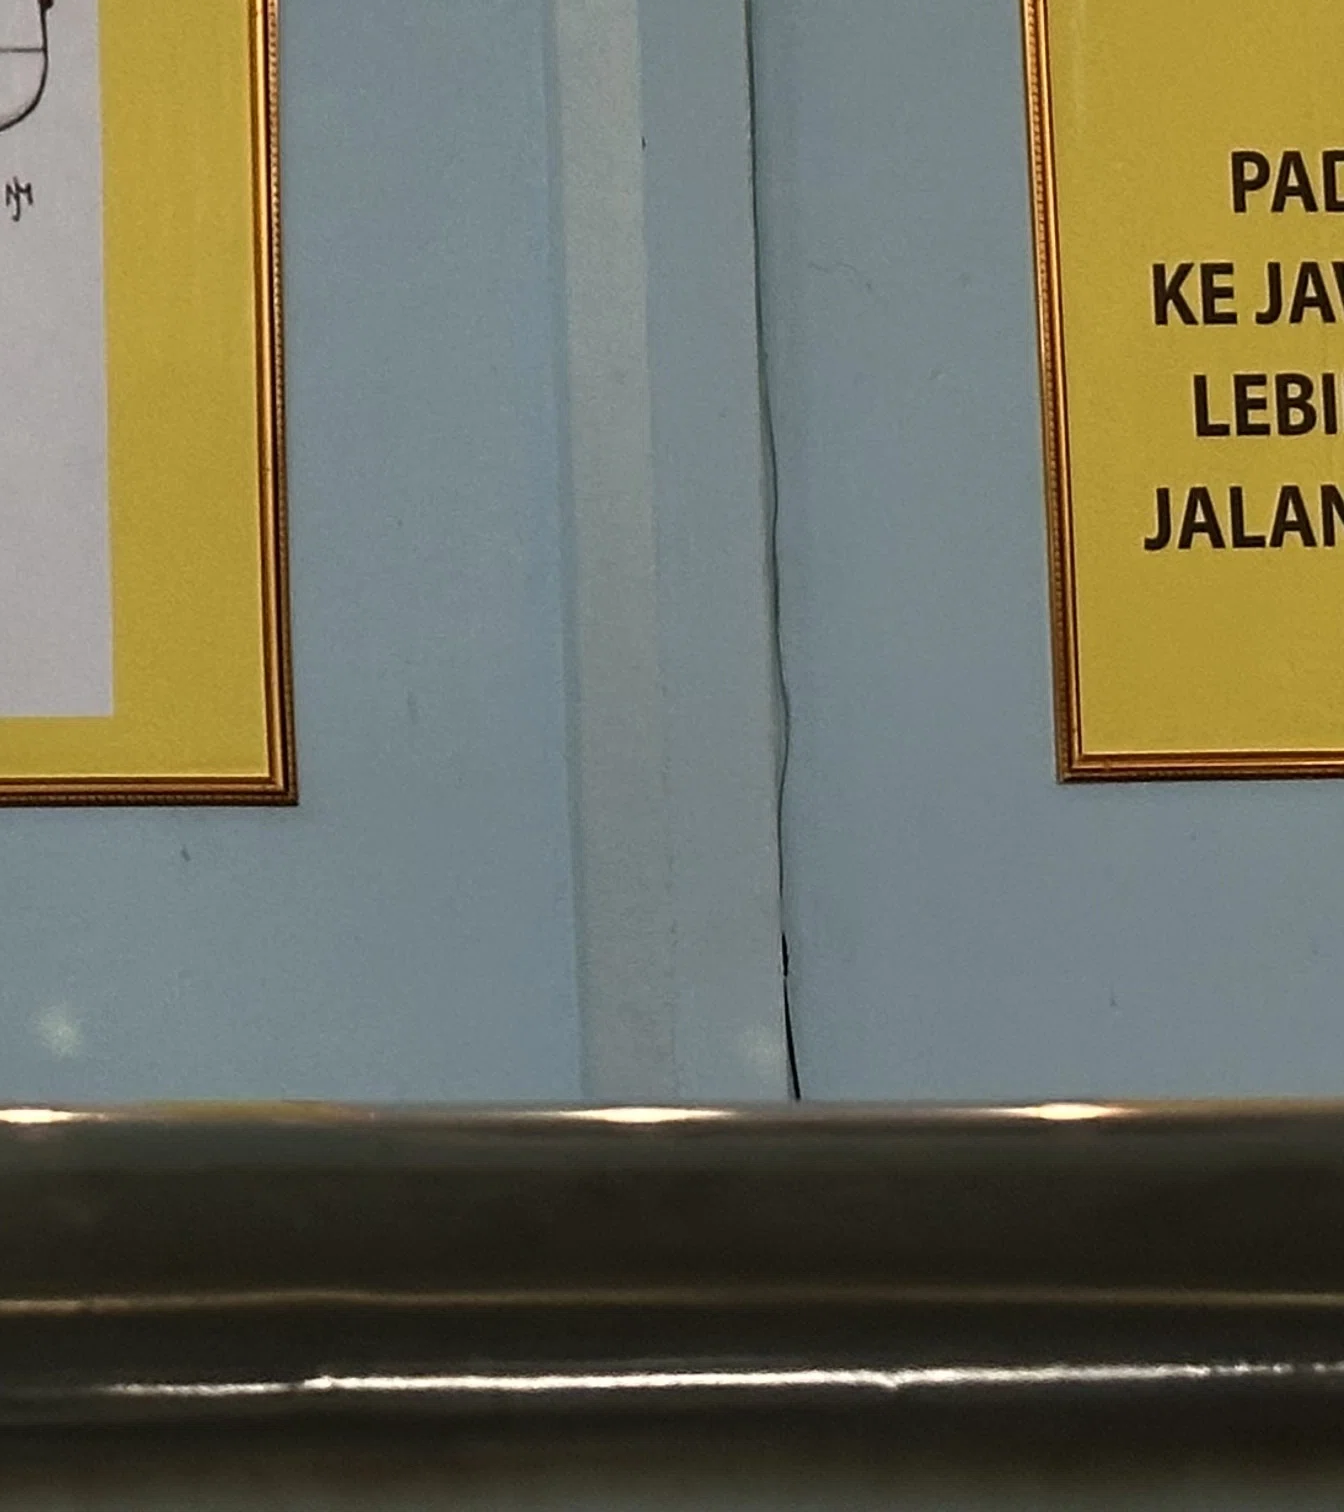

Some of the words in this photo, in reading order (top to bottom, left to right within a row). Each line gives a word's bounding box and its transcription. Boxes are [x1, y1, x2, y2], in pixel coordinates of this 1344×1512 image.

[1153, 263, 1237, 325] KE
[1256, 262, 1344, 324] JA
[1194, 373, 1338, 437] LEBI
